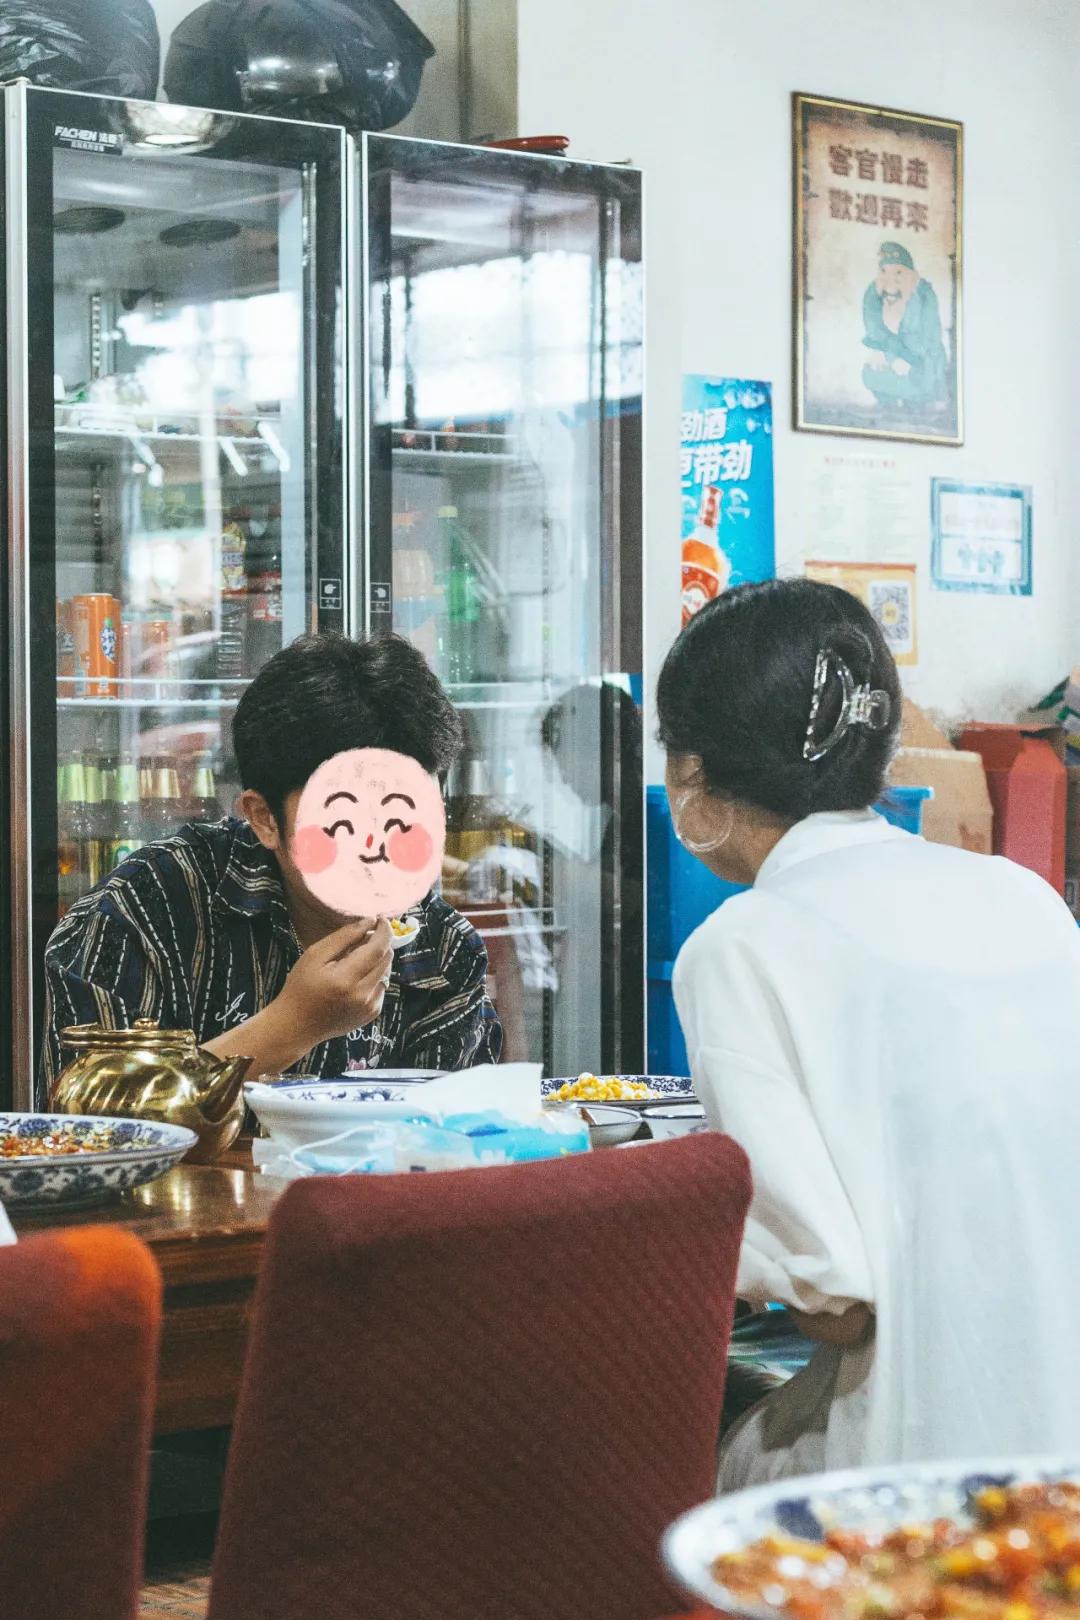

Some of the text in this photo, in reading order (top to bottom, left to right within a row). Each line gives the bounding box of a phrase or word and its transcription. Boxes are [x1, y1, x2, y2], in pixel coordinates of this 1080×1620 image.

[54, 125, 98, 142] FACHEN
[828, 143, 929, 189] 客官慢走
